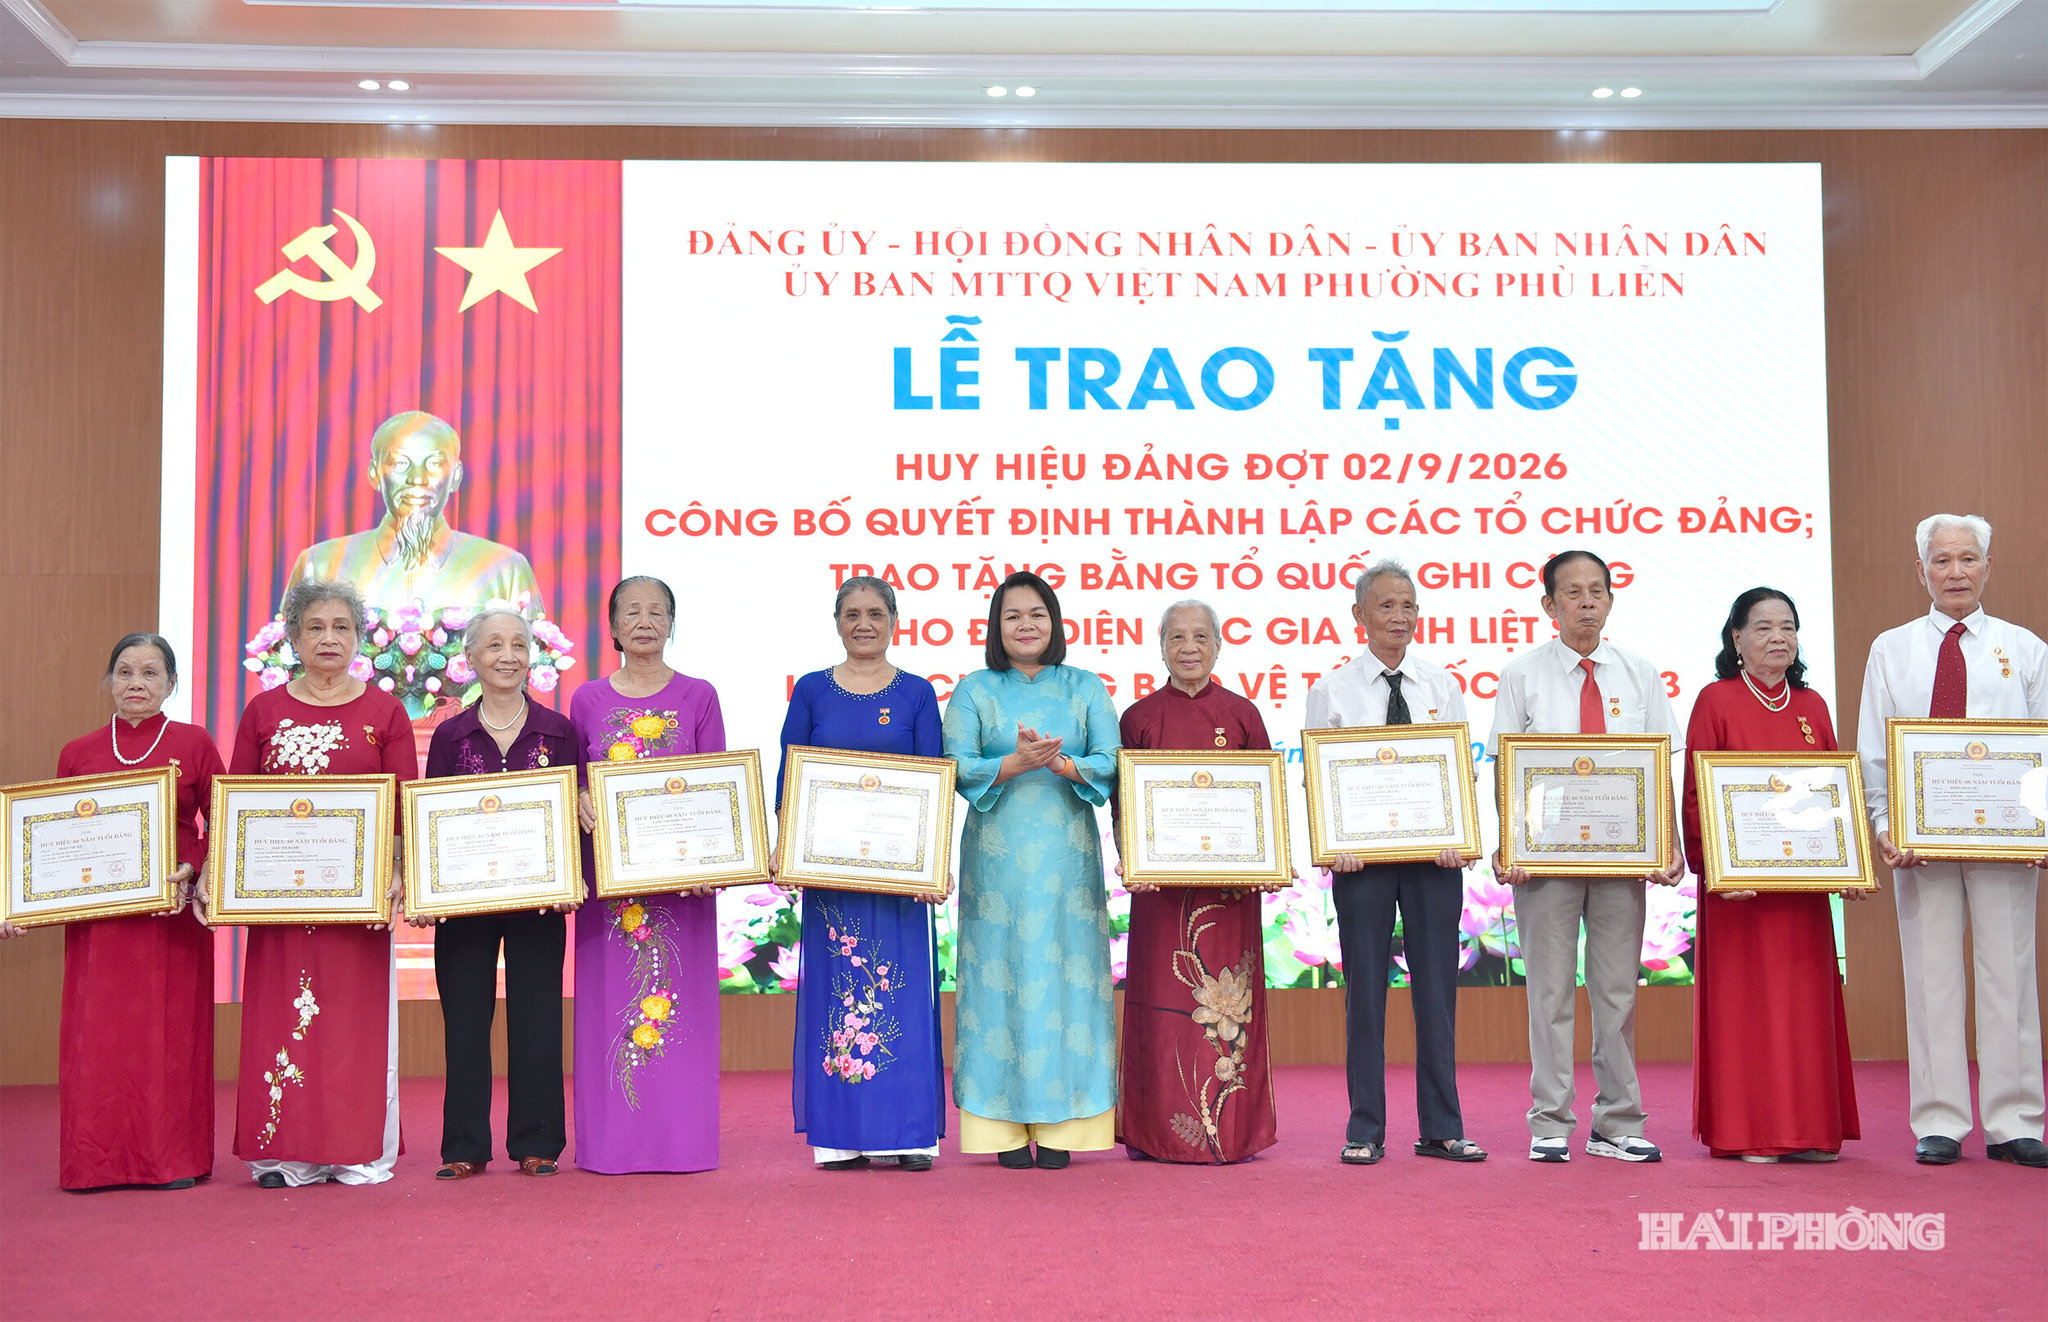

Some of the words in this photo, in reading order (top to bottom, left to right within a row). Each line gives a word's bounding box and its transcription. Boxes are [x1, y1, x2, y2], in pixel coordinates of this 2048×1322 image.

[688, 222, 806, 256] ĐẢNG
[821, 222, 877, 257] ỦY
[913, 226, 988, 264] HỘI
[1003, 223, 1123, 257] ĐỒNG
[1137, 223, 1252, 257] NHÂN
[1269, 223, 1350, 257] DÂN
[1390, 224, 1445, 257] ỦY
[1459, 231, 1538, 257] BAN
[1554, 223, 1668, 257] NHÂN
[1684, 223, 1766, 257] DÂN
[785, 264, 839, 297] ỦY
[853, 271, 934, 297] BAN
[950, 271, 1072, 303] MTTQ
[1084, 267, 1182, 305] VIỆT
[1195, 270, 1287, 297] NAM
[1303, 265, 1479, 298] PHƯỜNG
[1495, 265, 1574, 298] PHÙ
[893, 314, 983, 411] LỄ
[1015, 347, 1275, 412] TRAO
[1308, 329, 1578, 431] TẶNG
[896, 453, 980, 482] HUY
[995, 445, 1087, 489] HIỆU
[1102, 443, 1230, 482] ĐẢNG
[1244, 448, 1330, 489] ĐỢT
[1343, 452, 1568, 485] 02/9/2026
[644, 500, 779, 538] CÔNG
[793, 495, 853, 537] BỐ
[865, 495, 996, 537] QUYẾT
[1008, 508, 1111, 545] ĐỊNH
[1123, 498, 1264, 536] THÀNH
[1280, 498, 1353, 544] LẬP
[1365, 498, 1462, 536] CÁC
[1473, 490, 1528, 536] TỔ
[1540, 497, 1664, 535] CHỨC
[1676, 495, 1814, 540] ĐẢNG;
[1081, 548, 1198, 590] BẰNG
[1211, 547, 1263, 590] TỔ
[1277, 550, 1369, 589] QUỐ
[1418, 562, 1490, 589] GHI
[1506, 554, 1634, 589] CG
[892, 619, 953, 646] HO
[1267, 617, 1341, 645] GIA
[1470, 609, 1539, 652] LIỆT
[1239, 664, 1287, 708] VỆ
